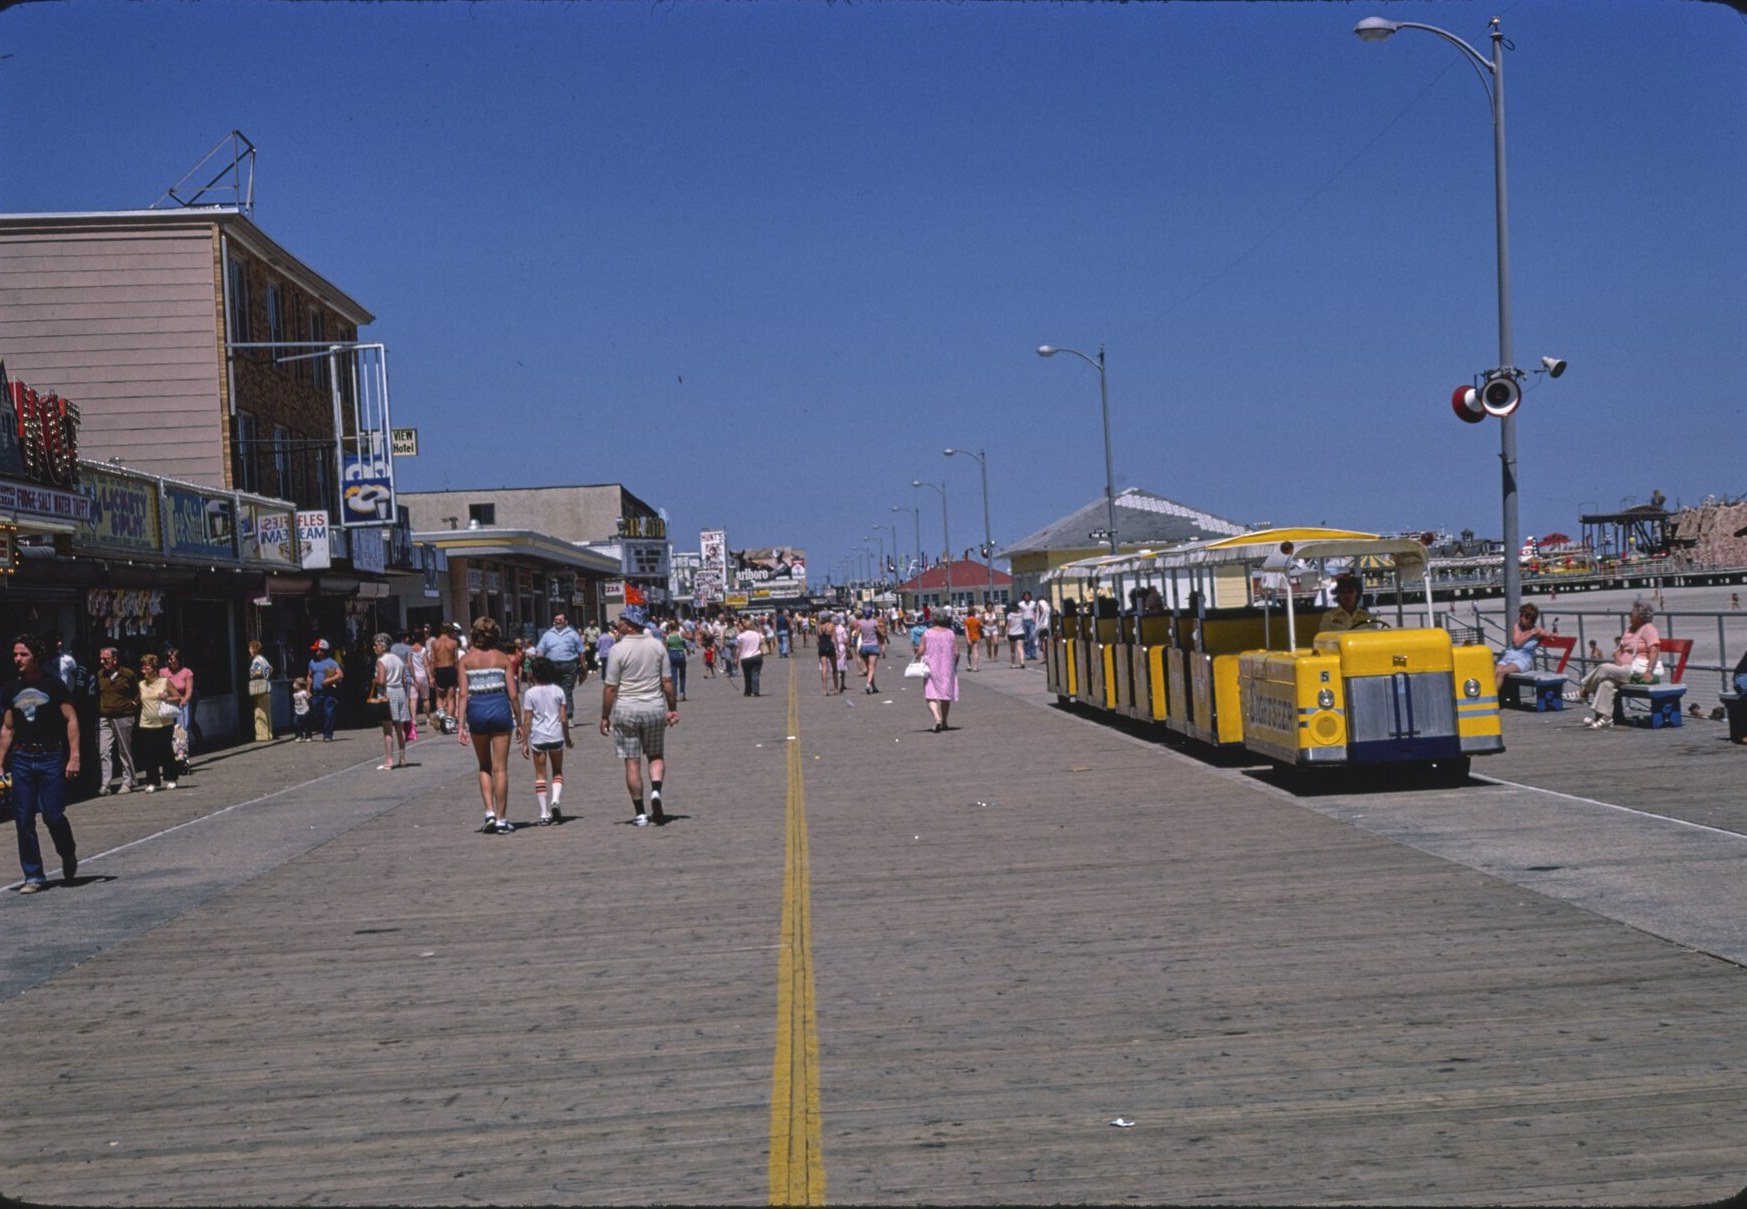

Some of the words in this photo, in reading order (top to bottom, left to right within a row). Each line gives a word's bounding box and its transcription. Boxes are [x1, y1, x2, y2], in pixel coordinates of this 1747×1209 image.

[394, 431, 412, 441] VIEW
[394, 443, 414, 453] Hotel
[54, 494, 71, 515] WATER
[73, 497, 89, 518] TAFFY
[1321, 671, 1329, 683] 5
